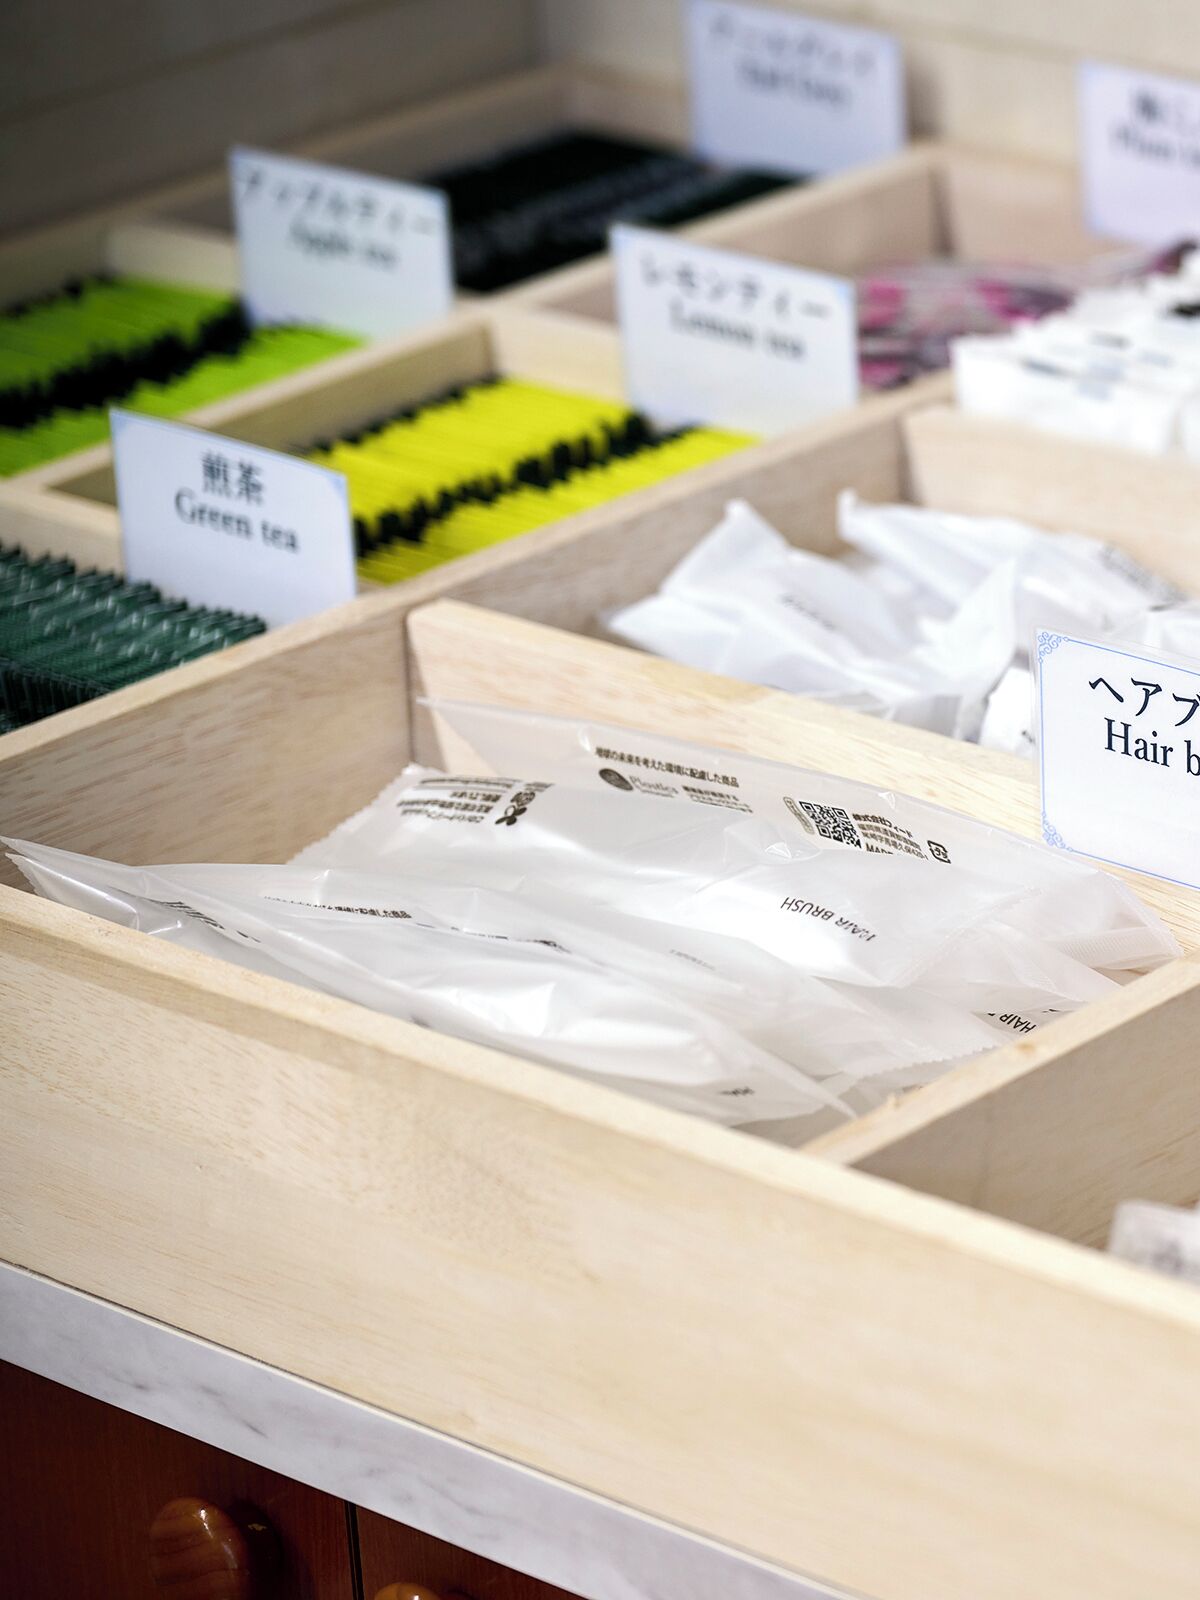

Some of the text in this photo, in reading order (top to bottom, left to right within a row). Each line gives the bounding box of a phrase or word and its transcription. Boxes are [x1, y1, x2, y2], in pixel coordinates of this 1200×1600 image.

[640, 253, 831, 319] レモンティー
[669, 297, 755, 347] Lemon
[201, 450, 263, 506] 煎茶
[174, 487, 299, 553] Green tea
[1104, 717, 1174, 767] Hair
[779, 897, 834, 921] BRUSH
[999, 1013, 1037, 1034] HAIR
